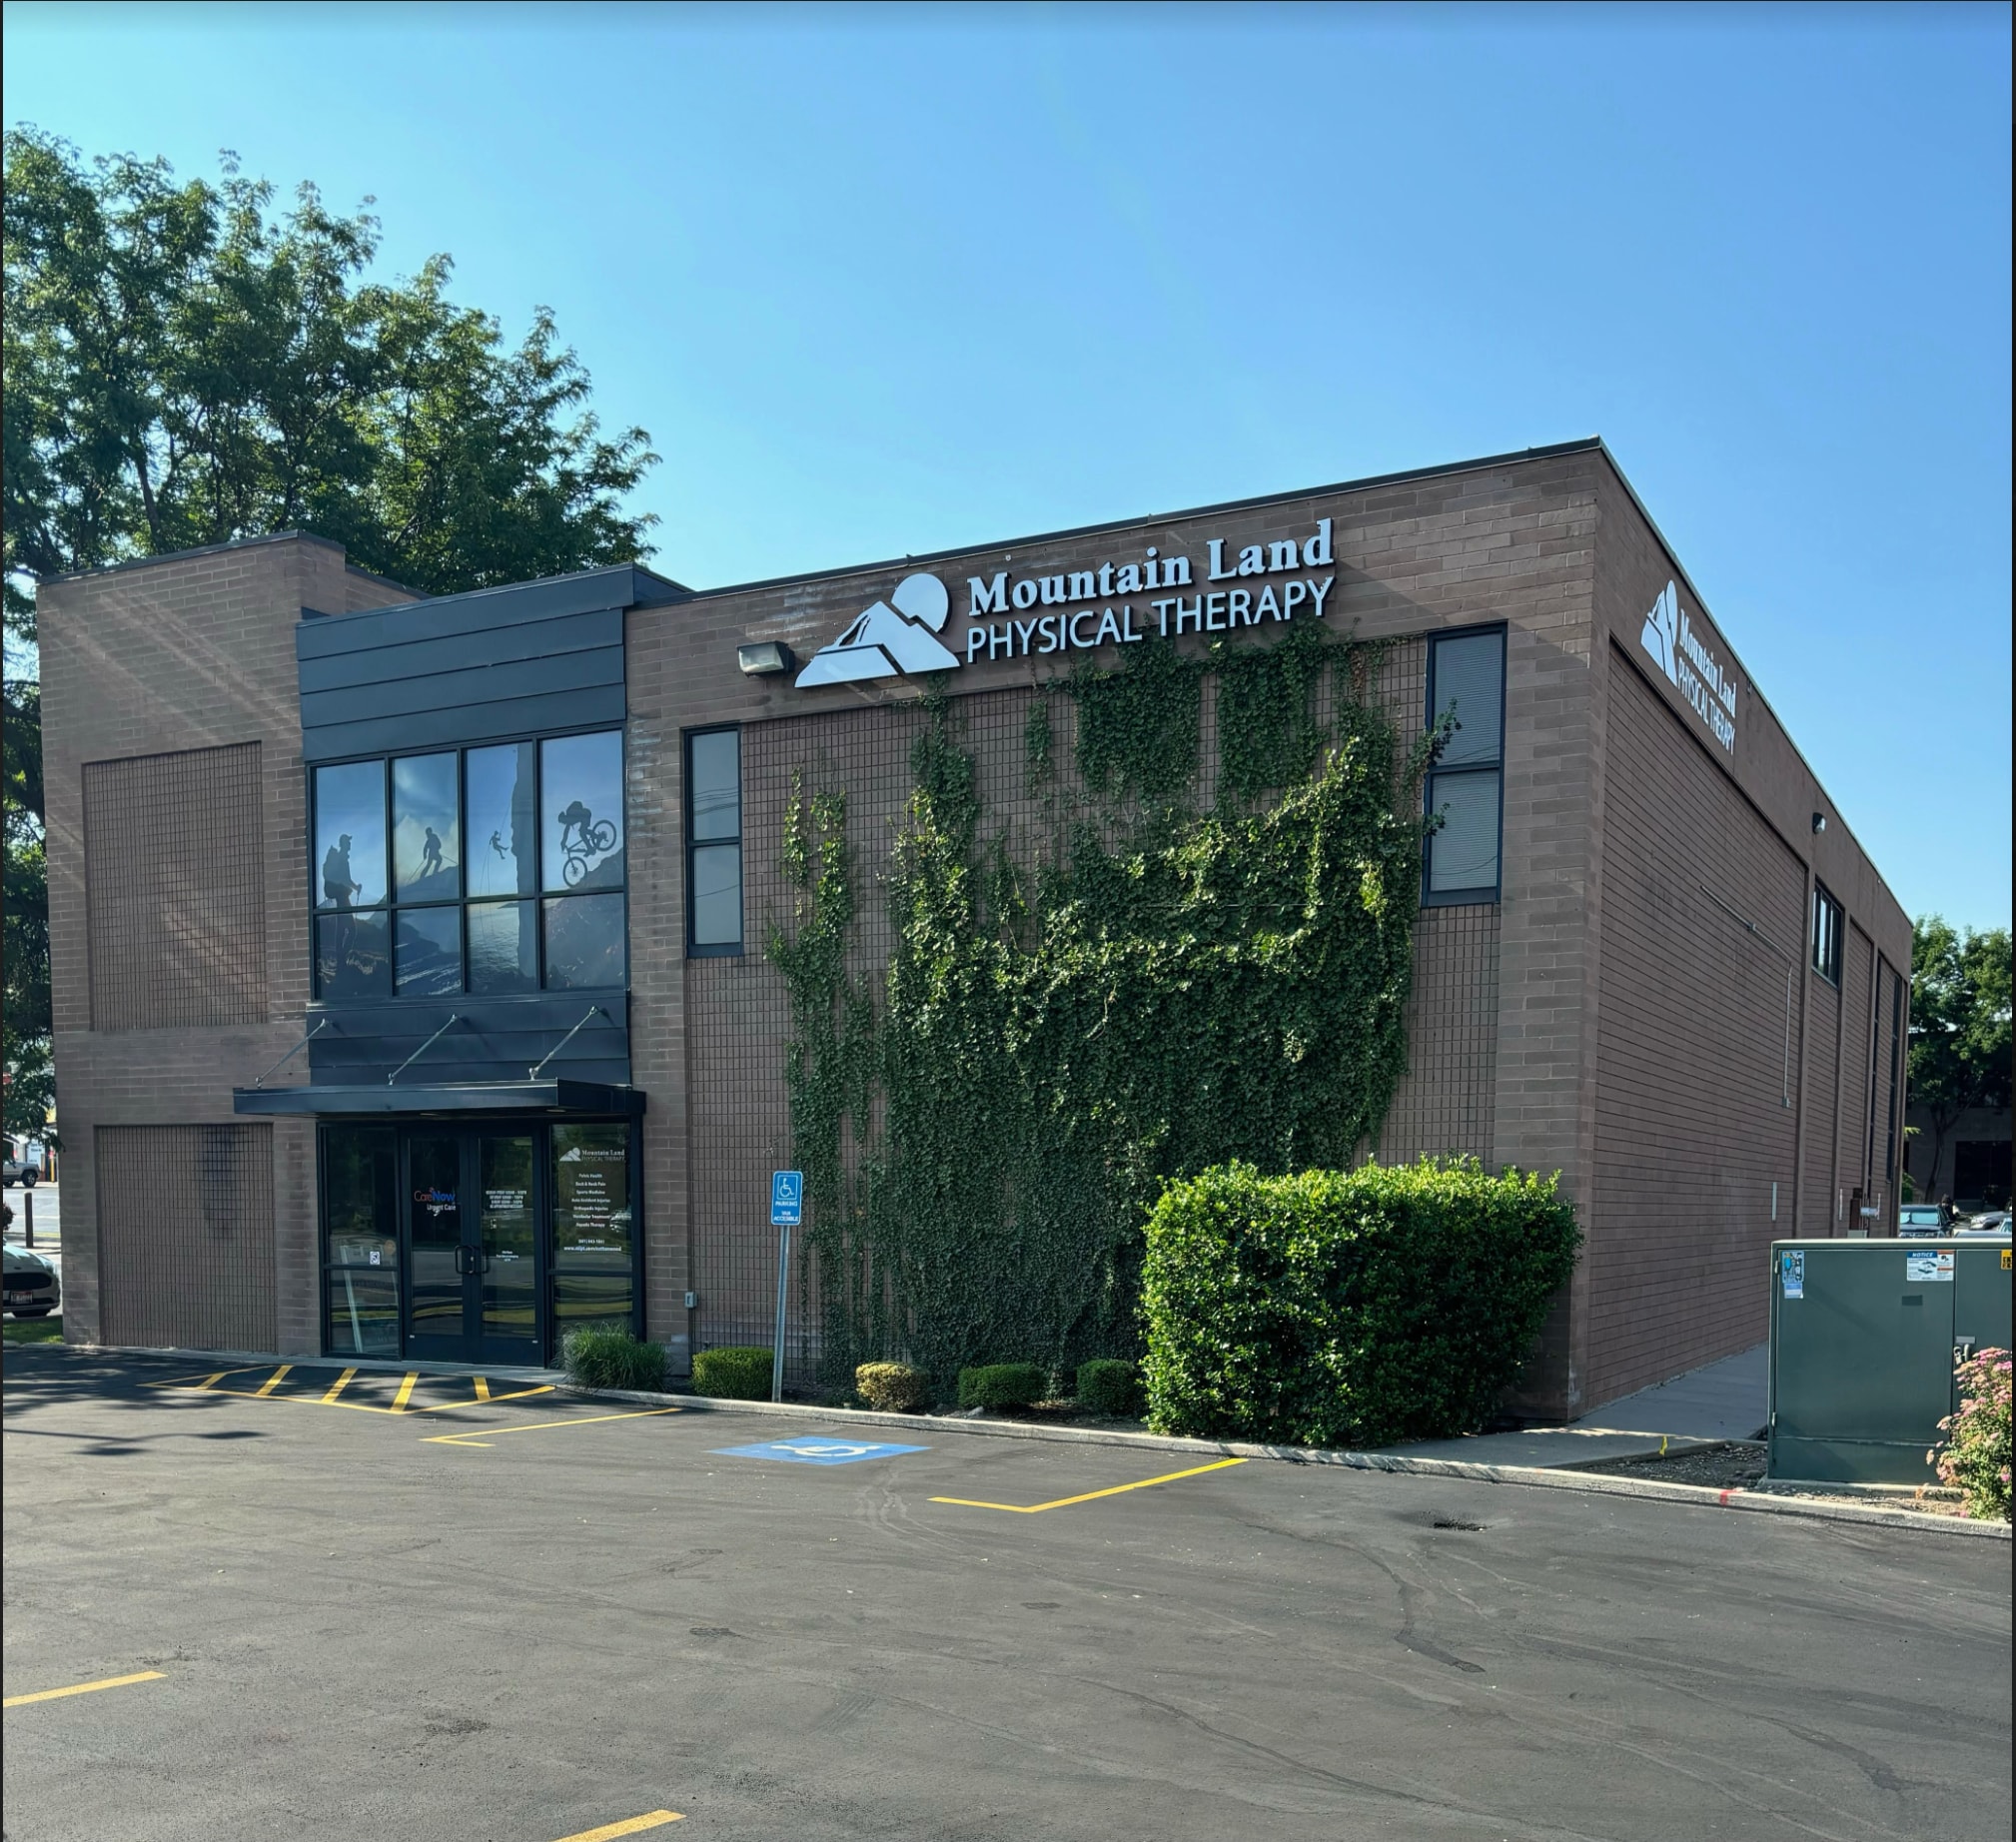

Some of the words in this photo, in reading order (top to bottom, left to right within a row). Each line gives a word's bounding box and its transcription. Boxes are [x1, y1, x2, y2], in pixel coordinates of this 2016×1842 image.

[967, 546, 1193, 616] Mountain
[1207, 517, 1335, 581] Land
[967, 604, 1143, 663] PHYSICAL
[1151, 575, 1335, 637] THERAPY
[1679, 608, 1717, 693] Mountain
[1718, 664, 1737, 718] Land
[1678, 656, 1708, 725] PHYSICAL
[1709, 697, 1735, 756] THERAPY
